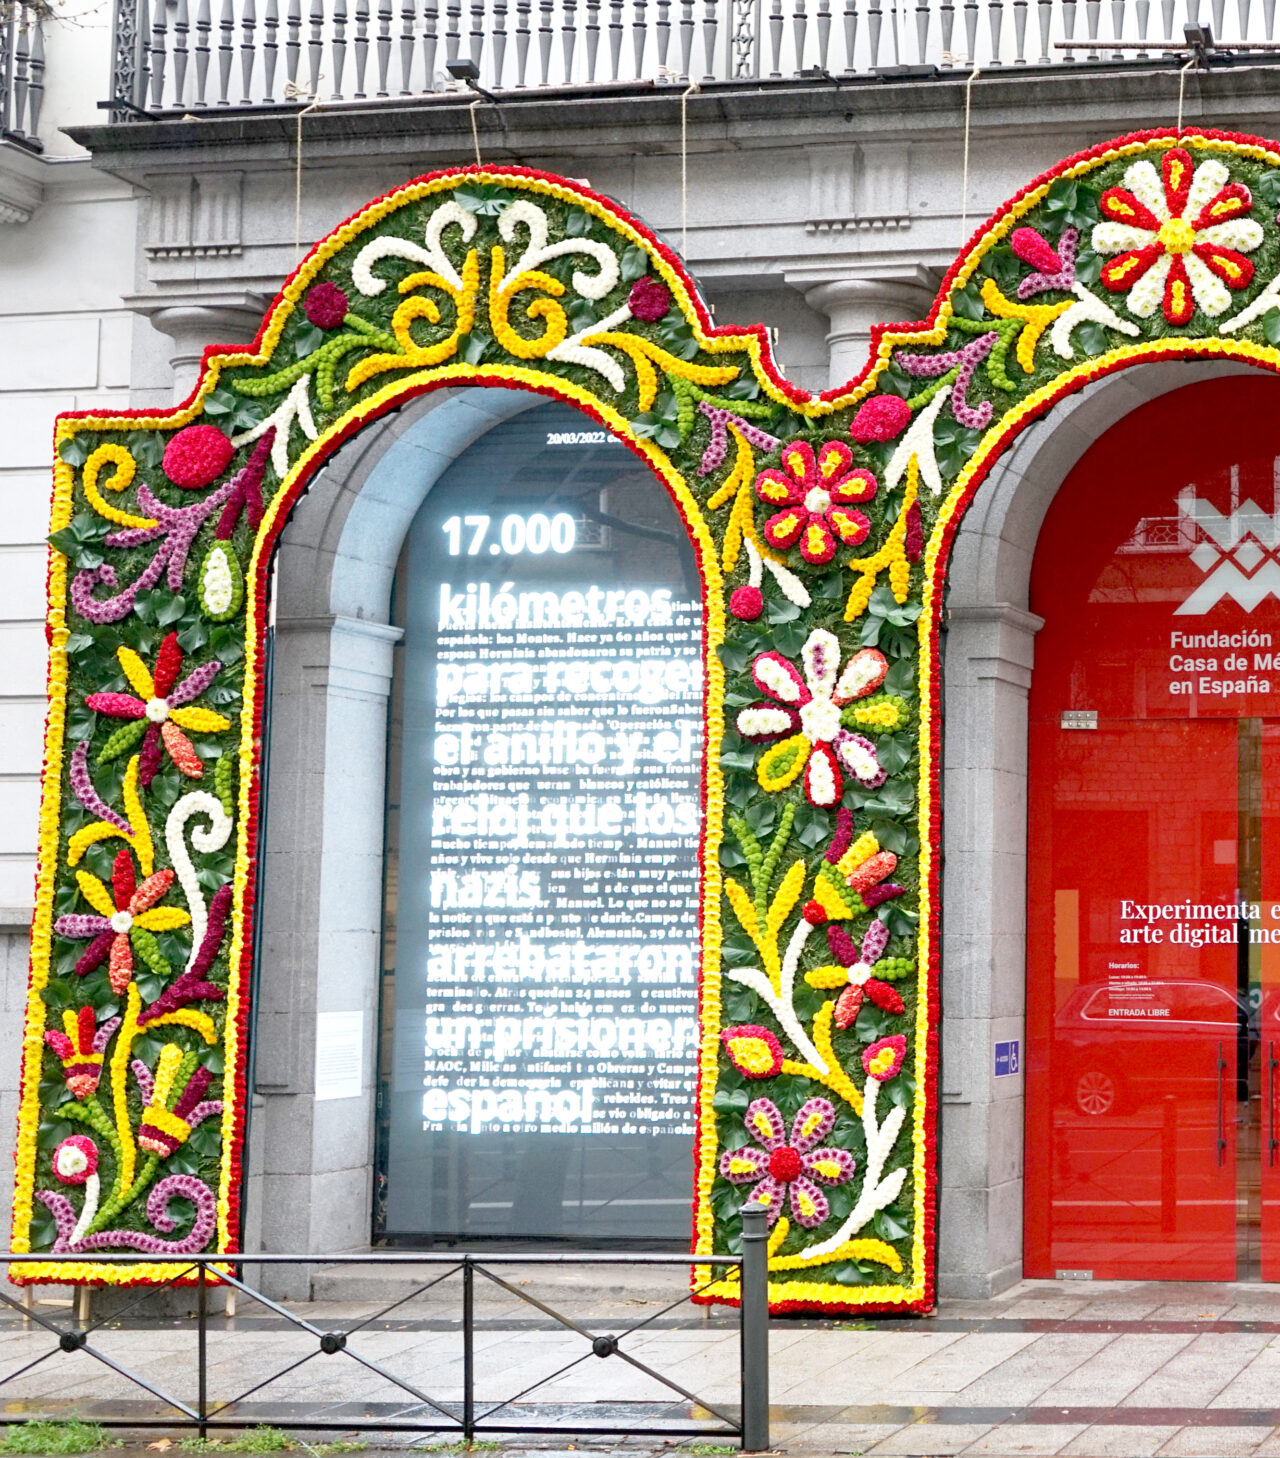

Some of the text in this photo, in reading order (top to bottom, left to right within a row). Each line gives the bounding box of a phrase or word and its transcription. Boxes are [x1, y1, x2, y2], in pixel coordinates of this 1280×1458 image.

[547, 432, 605, 444] 20/03/2022
[442, 513, 576, 555] 17.000
[438, 582, 673, 626] kilómetros
[437, 635, 493, 646] española:
[496, 634, 513, 644] los
[517, 633, 563, 644] Montes.
[567, 632, 597, 643] Hace
[600, 633, 613, 646] ya
[635, 631, 664, 642] años
[666, 633, 688, 644] que
[1171, 629, 1272, 649] Fundación
[437, 646, 696, 661] esposa Herminia abandonaron su patria y se
[1169, 654, 1218, 672] Casa
[1223, 653, 1248, 671] de
[436, 663, 533, 706] para
[1169, 676, 1270, 698] en España
[510, 692, 554, 705] campos
[557, 690, 572, 702] de
[458, 706, 475, 717] los
[477, 708, 499, 719] que
[501, 708, 534, 719] pasas
[537, 705, 555, 717] sin
[558, 704, 590, 716] saber
[592, 706, 614, 718] que
[617, 704, 628, 715] lo
[434, 723, 472, 765] el
[615, 731, 643, 775] y
[653, 721, 692, 763] el
[462, 767, 469, 777] y
[487, 765, 540, 777] gobierno
[433, 778, 688, 792] trabajadores que blancos y católicos
[431, 792, 700, 847] reloj que los
[637, 837, 681, 849] Manuel
[431, 853, 458, 864] años
[461, 855, 468, 866] y
[470, 854, 493, 864] vive
[523, 852, 557, 864] desde
[430, 864, 541, 909] nazis
[614, 882, 692, 895] de que el que
[608, 897, 623, 909] Lo
[626, 899, 648, 910] que
[651, 898, 667, 908] no
[670, 898, 682, 908] se
[1120, 899, 1261, 923] Experimenta
[485, 913, 507, 925] que
[681, 911, 696, 923] de
[668, 927, 683, 938] de
[1119, 925, 1164, 944] arte
[1169, 923, 1239, 948] digital
[426, 937, 693, 979] arrebataron
[528, 987, 573, 999] quedan
[594, 987, 631, 998] meses
[422, 1082, 593, 1134] español
[581, 1120, 618, 1133] millón
[622, 1121, 636, 1134] de
